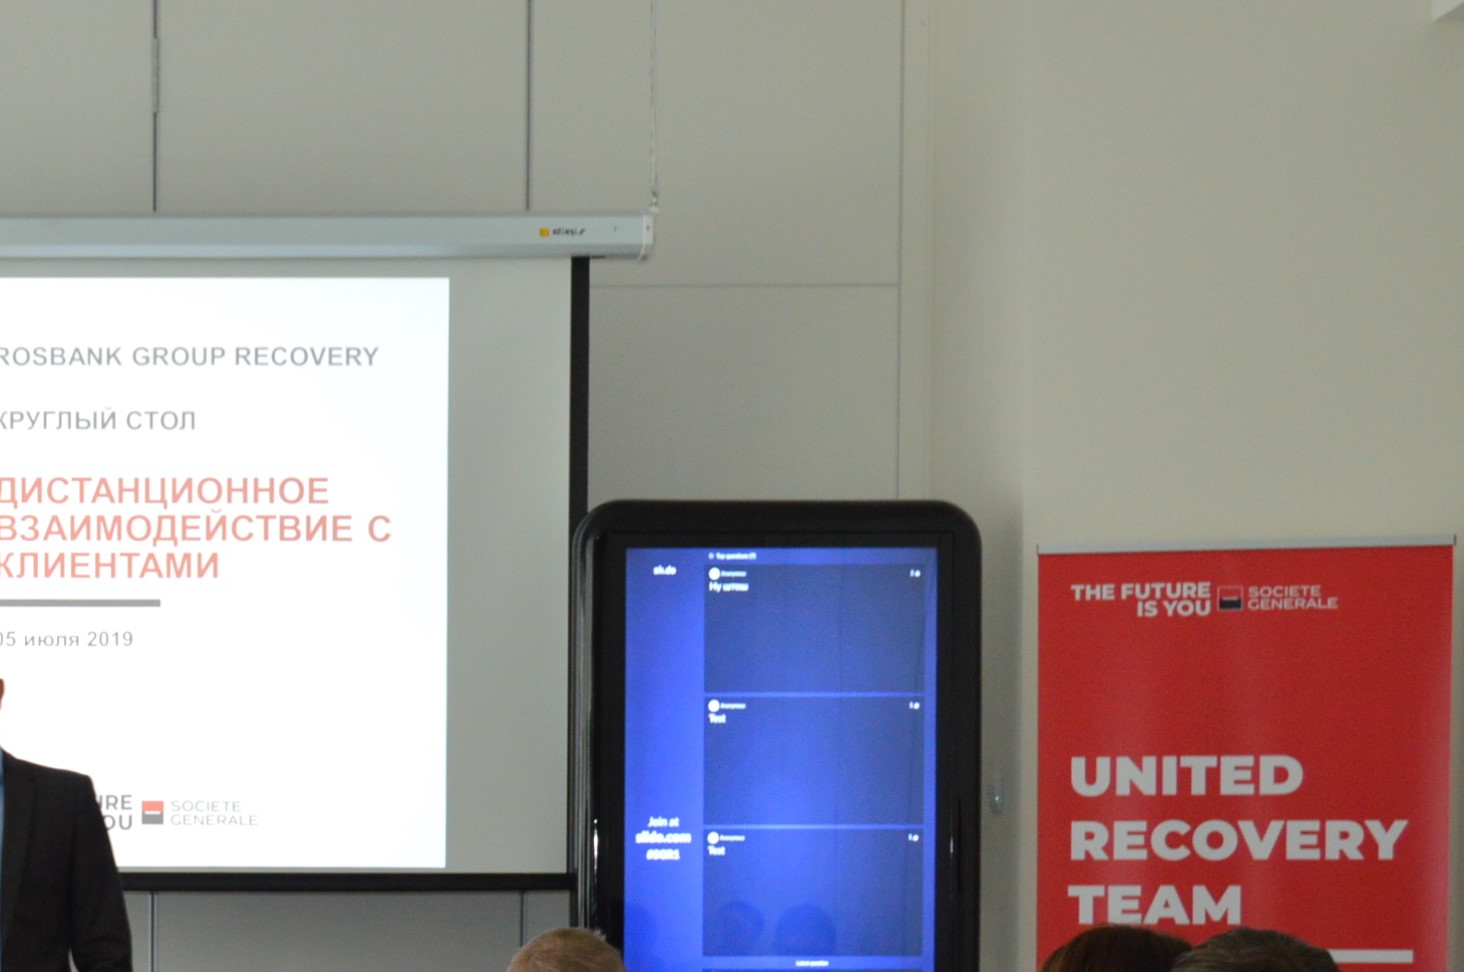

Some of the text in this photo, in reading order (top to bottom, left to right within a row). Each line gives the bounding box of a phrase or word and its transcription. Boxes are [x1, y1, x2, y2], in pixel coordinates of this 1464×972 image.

[132, 346, 226, 367] GROUP
[235, 346, 380, 367] RECOVERY
[125, 410, 197, 431] СТОЛ
[367, 514, 393, 543] С
[1069, 581, 1212, 600] THE FUTURE
[1247, 584, 1321, 597] SOCIETE
[1136, 600, 1211, 617] IS YOU
[1247, 596, 1338, 610] GENERALE
[24, 636, 79, 647] июля
[87, 631, 133, 647] 2019
[1069, 755, 1304, 798] UNITED
[97, 794, 133, 810] RE
[170, 800, 241, 812] SOCIETE
[170, 813, 258, 826] GENERALE
[1069, 819, 1409, 862] RECOVERY
[1066, 884, 1242, 926] TEAM
